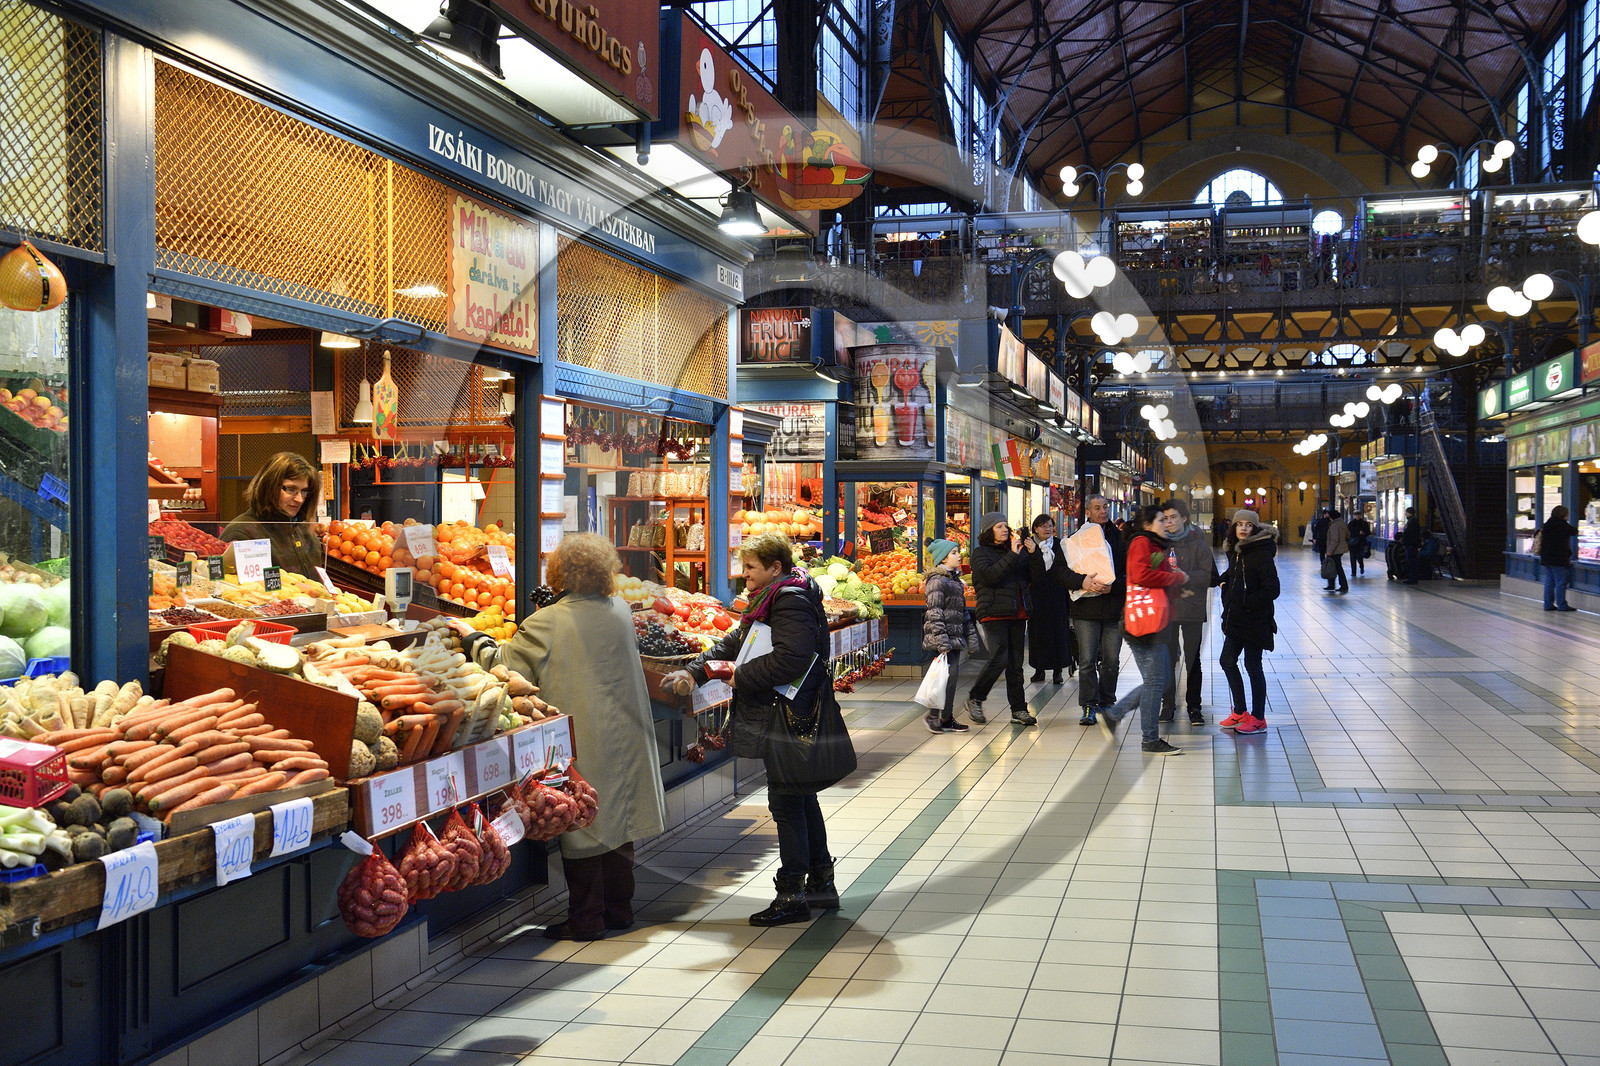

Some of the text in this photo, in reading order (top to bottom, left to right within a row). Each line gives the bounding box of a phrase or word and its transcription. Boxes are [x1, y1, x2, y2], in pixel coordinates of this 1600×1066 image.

[428, 123, 656, 255] IZSÁKI BOROK NAGY VÁLASZTÉKBAN
[468, 257, 521, 296] darálva is
[465, 284, 530, 339] kapható!
[750, 309, 805, 322] NATURAL
[750, 320, 803, 340] FRUIT
[746, 341, 801, 361] JUICE
[520, 750, 535, 769] 160
[483, 762, 500, 782] 698
[381, 802, 403, 825] 398
